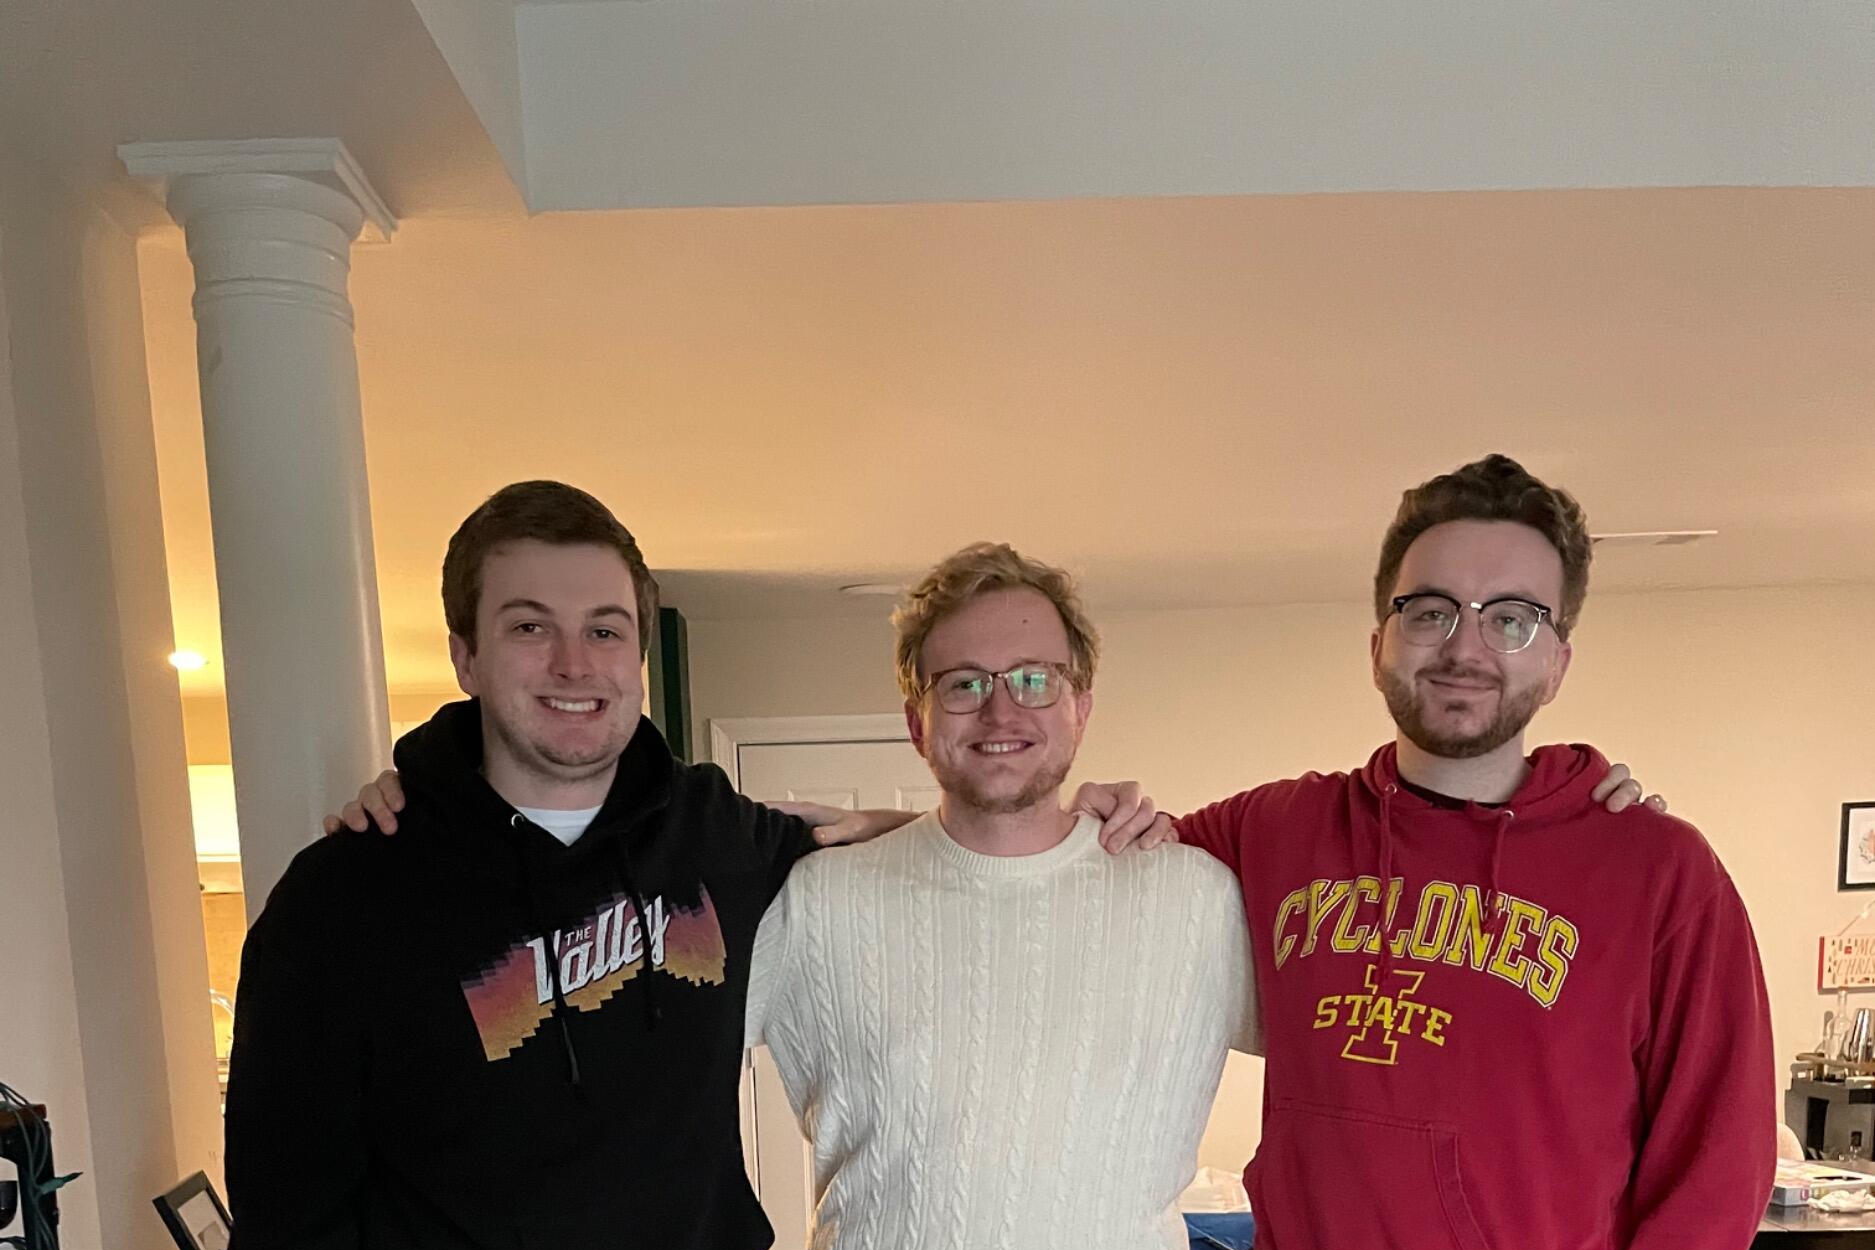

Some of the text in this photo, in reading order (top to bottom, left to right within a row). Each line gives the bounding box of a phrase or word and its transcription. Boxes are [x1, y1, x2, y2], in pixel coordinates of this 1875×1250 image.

[526, 895, 670, 1004] Valley
[565, 925, 592, 946] THE
[1273, 875, 1579, 1008] CYCLONES
[1312, 994, 1452, 1046] STATE
